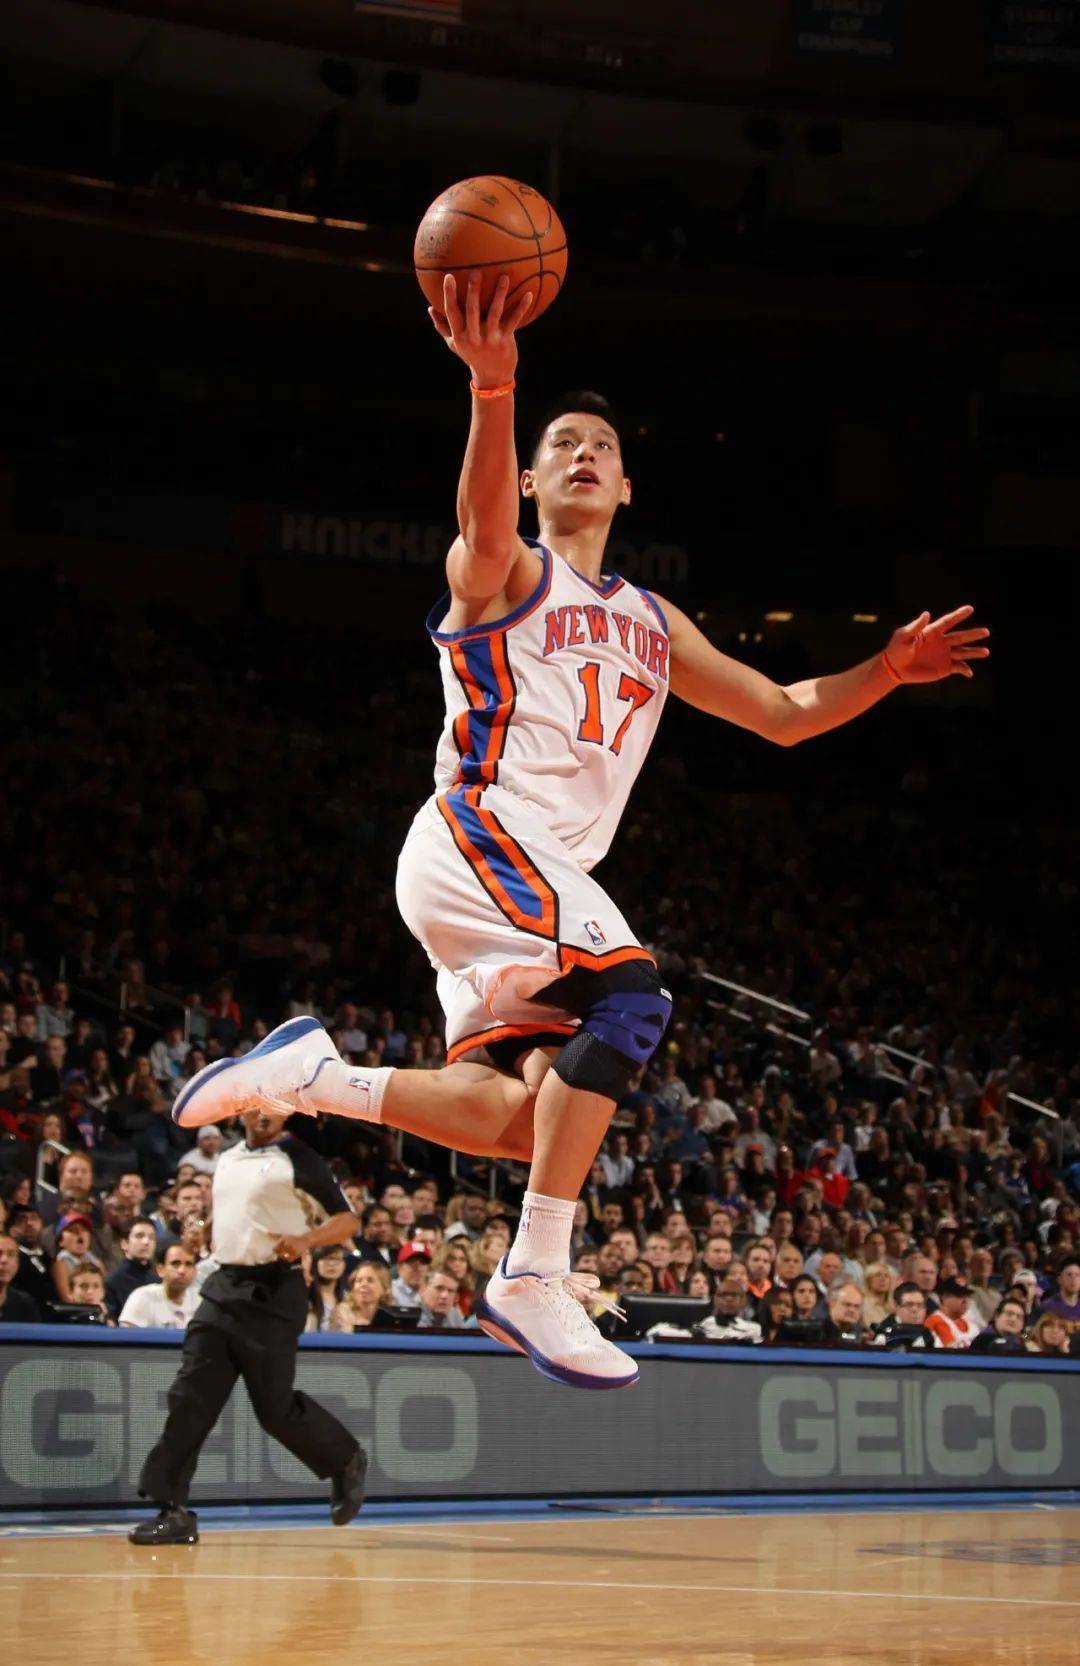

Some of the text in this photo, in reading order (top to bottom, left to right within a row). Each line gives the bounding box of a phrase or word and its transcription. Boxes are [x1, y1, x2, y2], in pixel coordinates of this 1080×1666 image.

[543, 604, 670, 681] NEW YOR
[577, 661, 656, 757] 17
[758, 1374, 1063, 1478] GEICO
